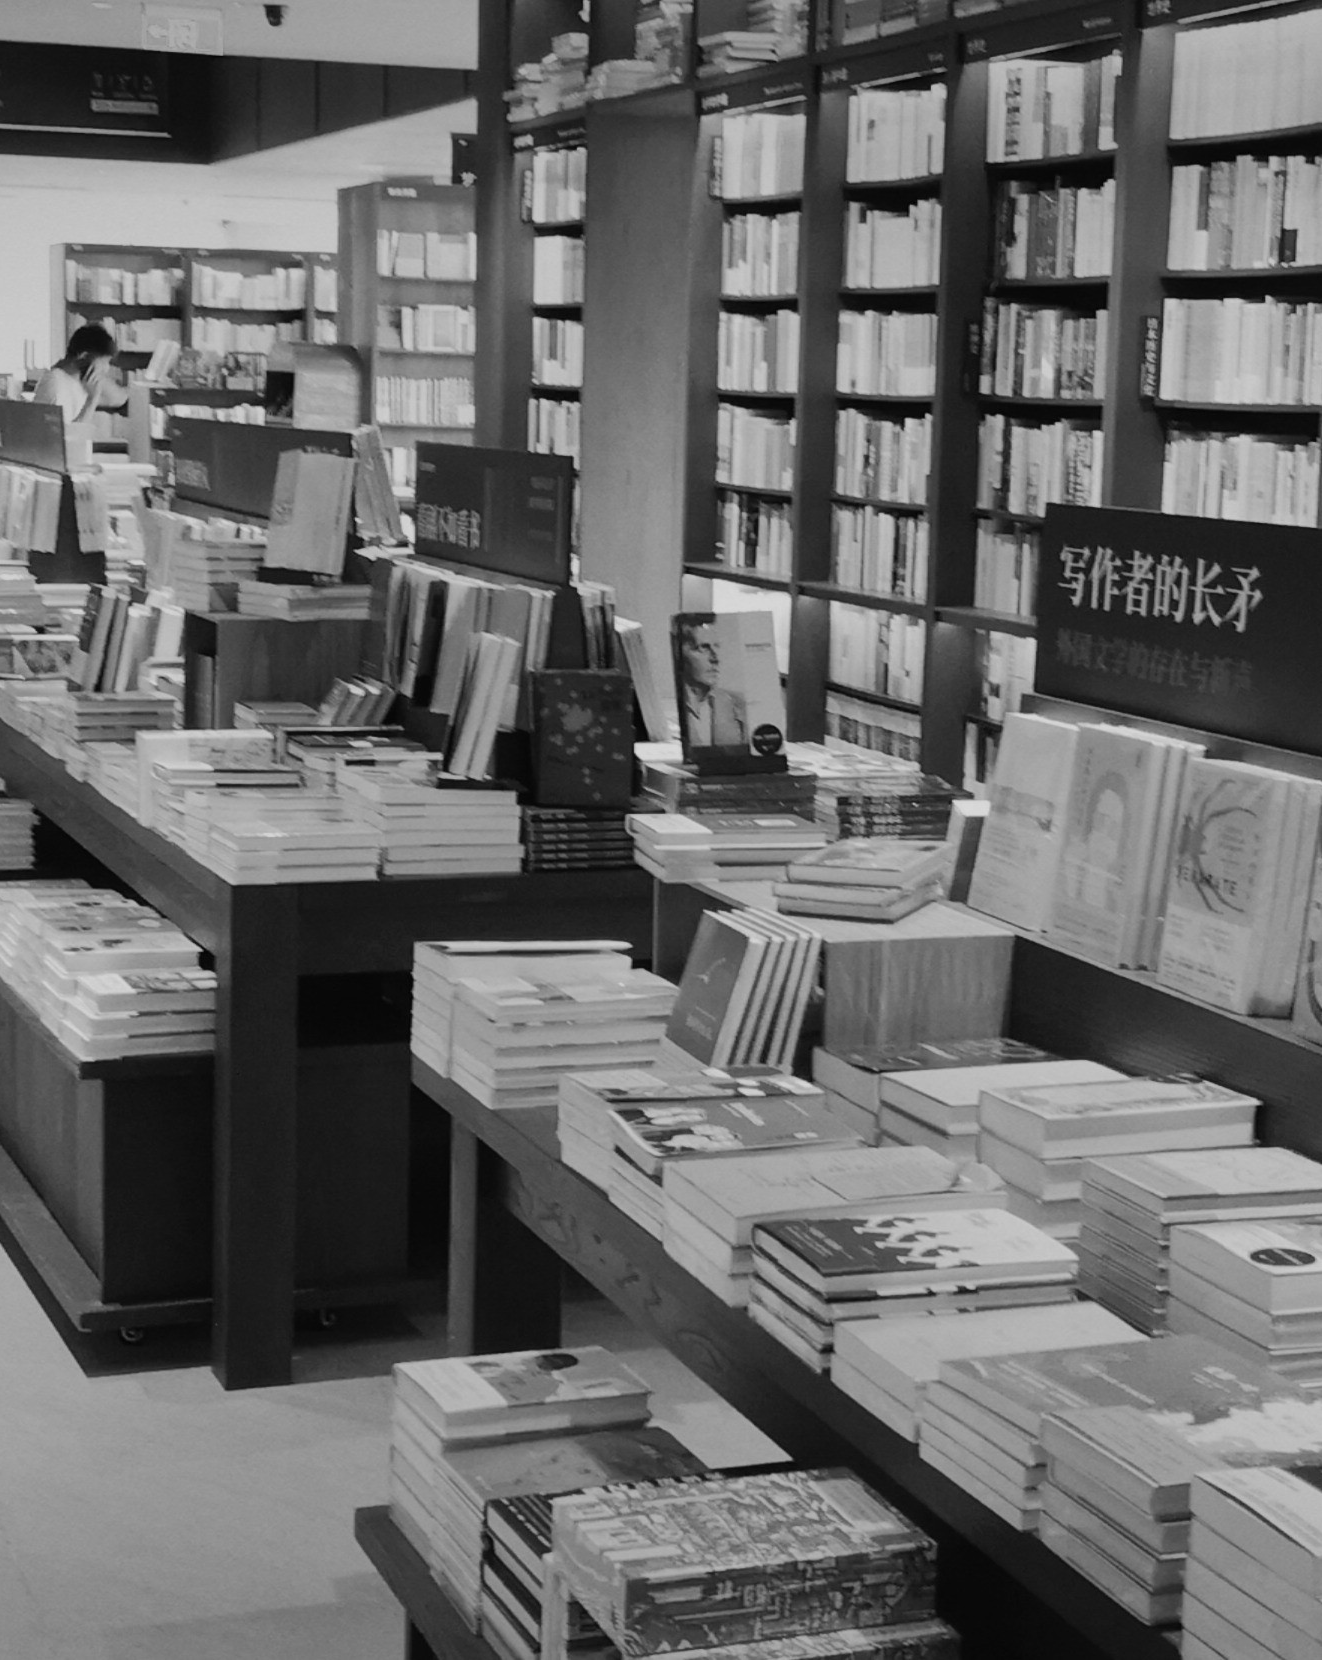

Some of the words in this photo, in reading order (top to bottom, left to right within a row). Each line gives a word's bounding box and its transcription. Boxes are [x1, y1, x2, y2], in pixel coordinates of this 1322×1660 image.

[1056, 544, 1265, 634] 写作者的长矛
